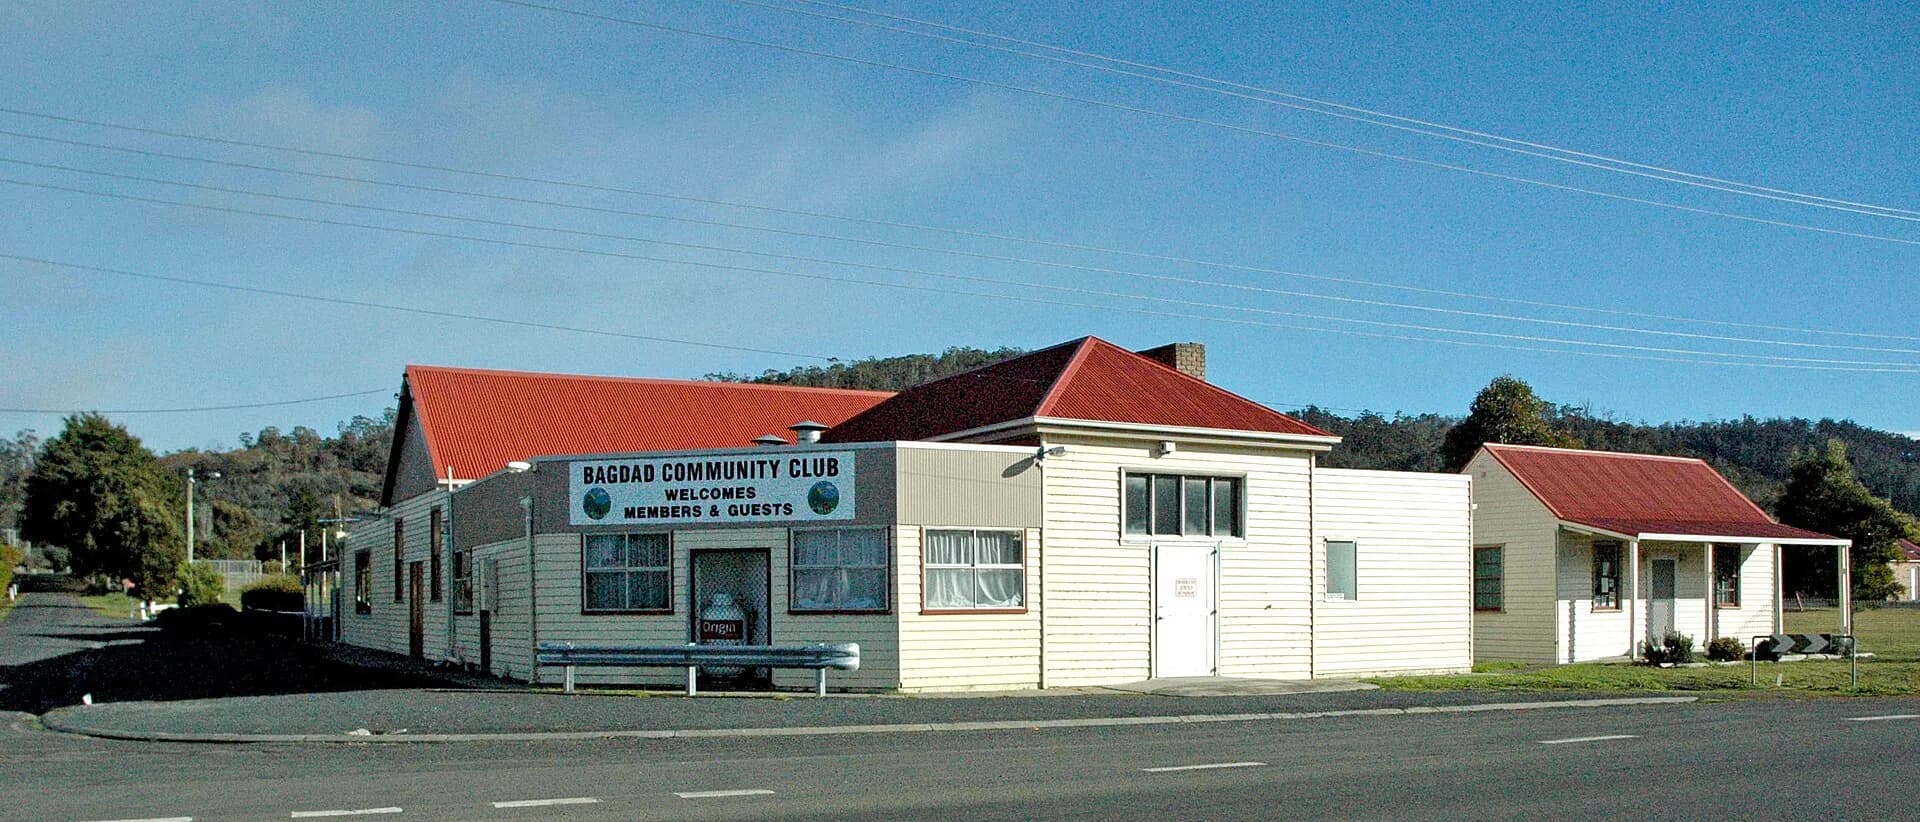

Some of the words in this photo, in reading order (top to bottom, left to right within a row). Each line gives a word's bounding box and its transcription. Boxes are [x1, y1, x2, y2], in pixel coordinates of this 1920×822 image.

[583, 464, 655, 485] BAGDAD
[662, 460, 781, 481] COMMUNITY
[788, 457, 840, 478] CLUB
[664, 486, 757, 501] WELCOMES
[623, 505, 702, 519] MEMBERS
[709, 504, 721, 517] &
[727, 502, 794, 516] GUESTS
[703, 621, 736, 635] Origin
